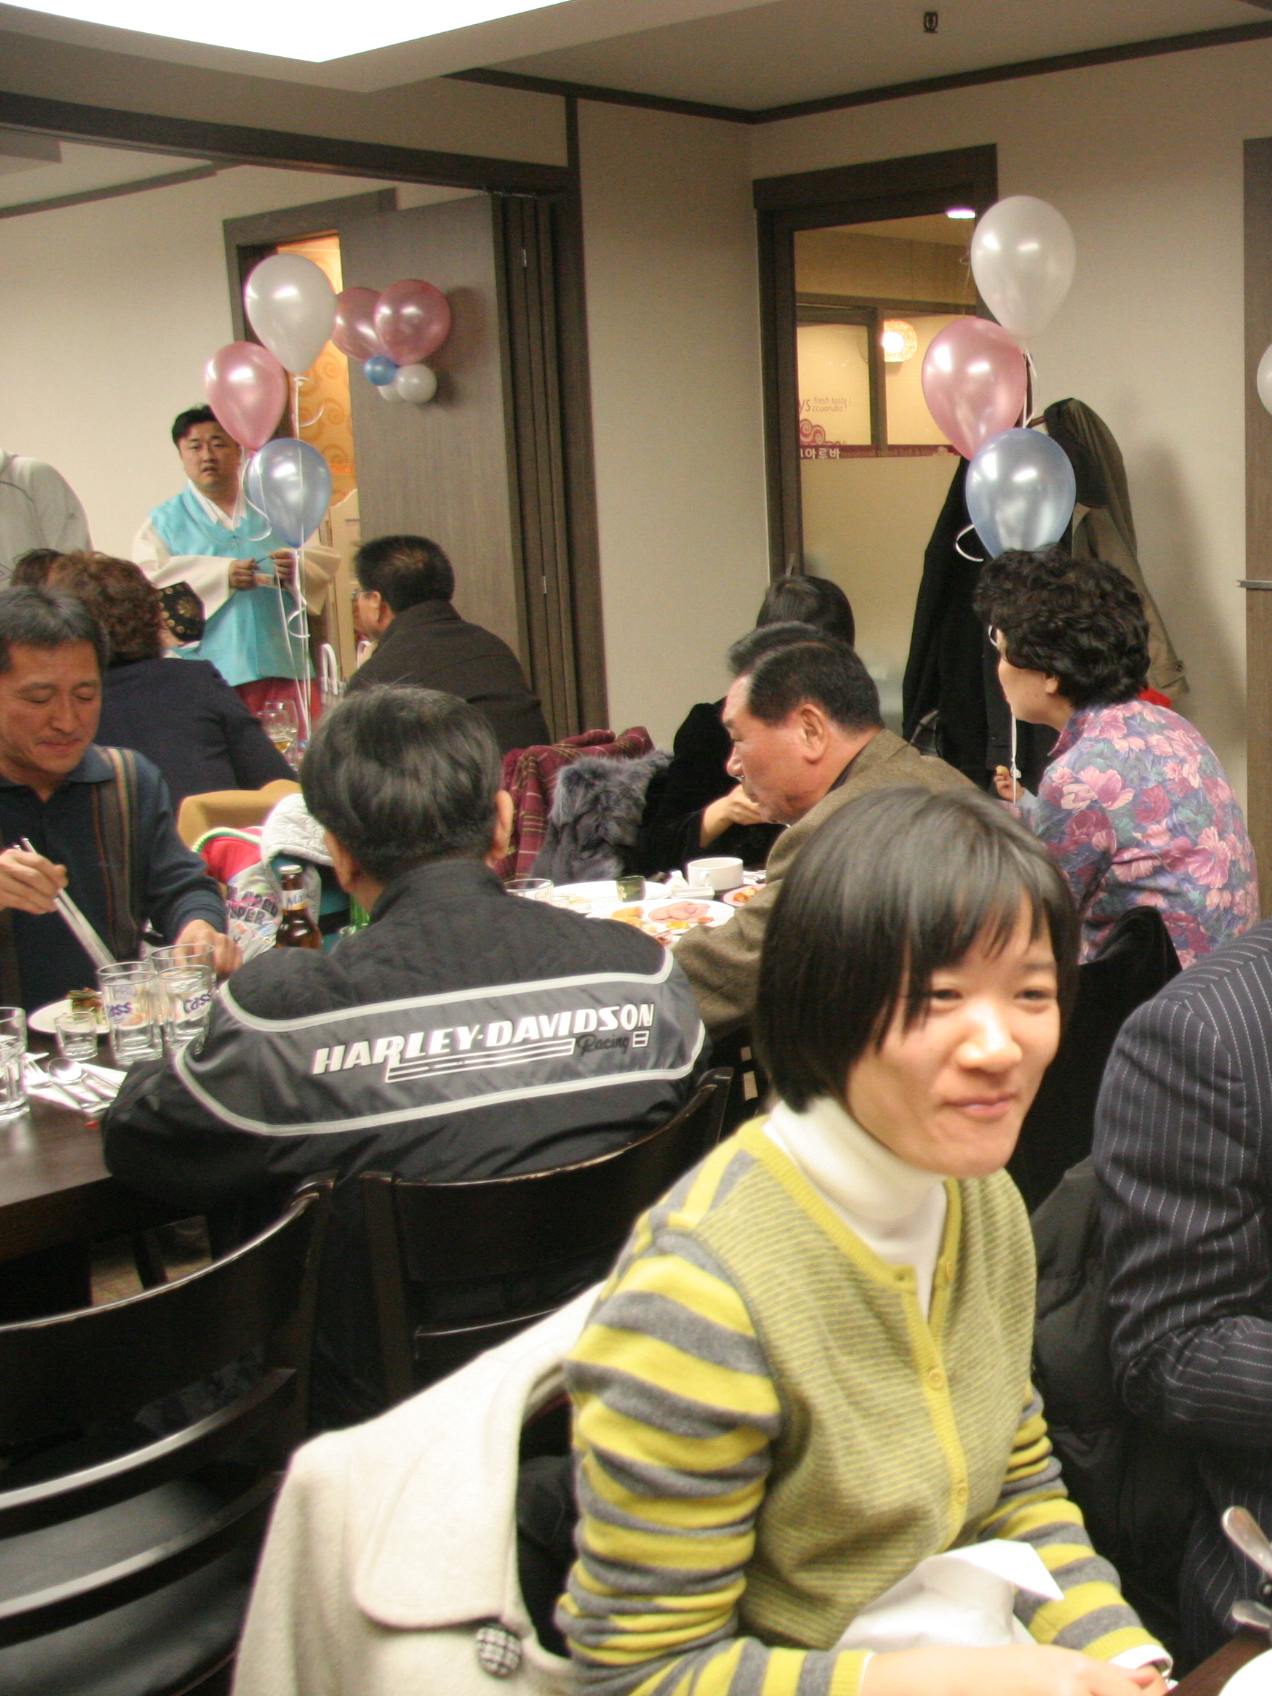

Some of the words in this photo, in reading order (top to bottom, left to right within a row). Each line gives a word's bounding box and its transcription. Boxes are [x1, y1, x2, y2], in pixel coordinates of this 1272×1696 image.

[800, 448, 841, 460] 아루바
[311, 1002, 655, 1076] HARLEY-DAVIDSON
[576, 1033, 630, 1057] Racing
